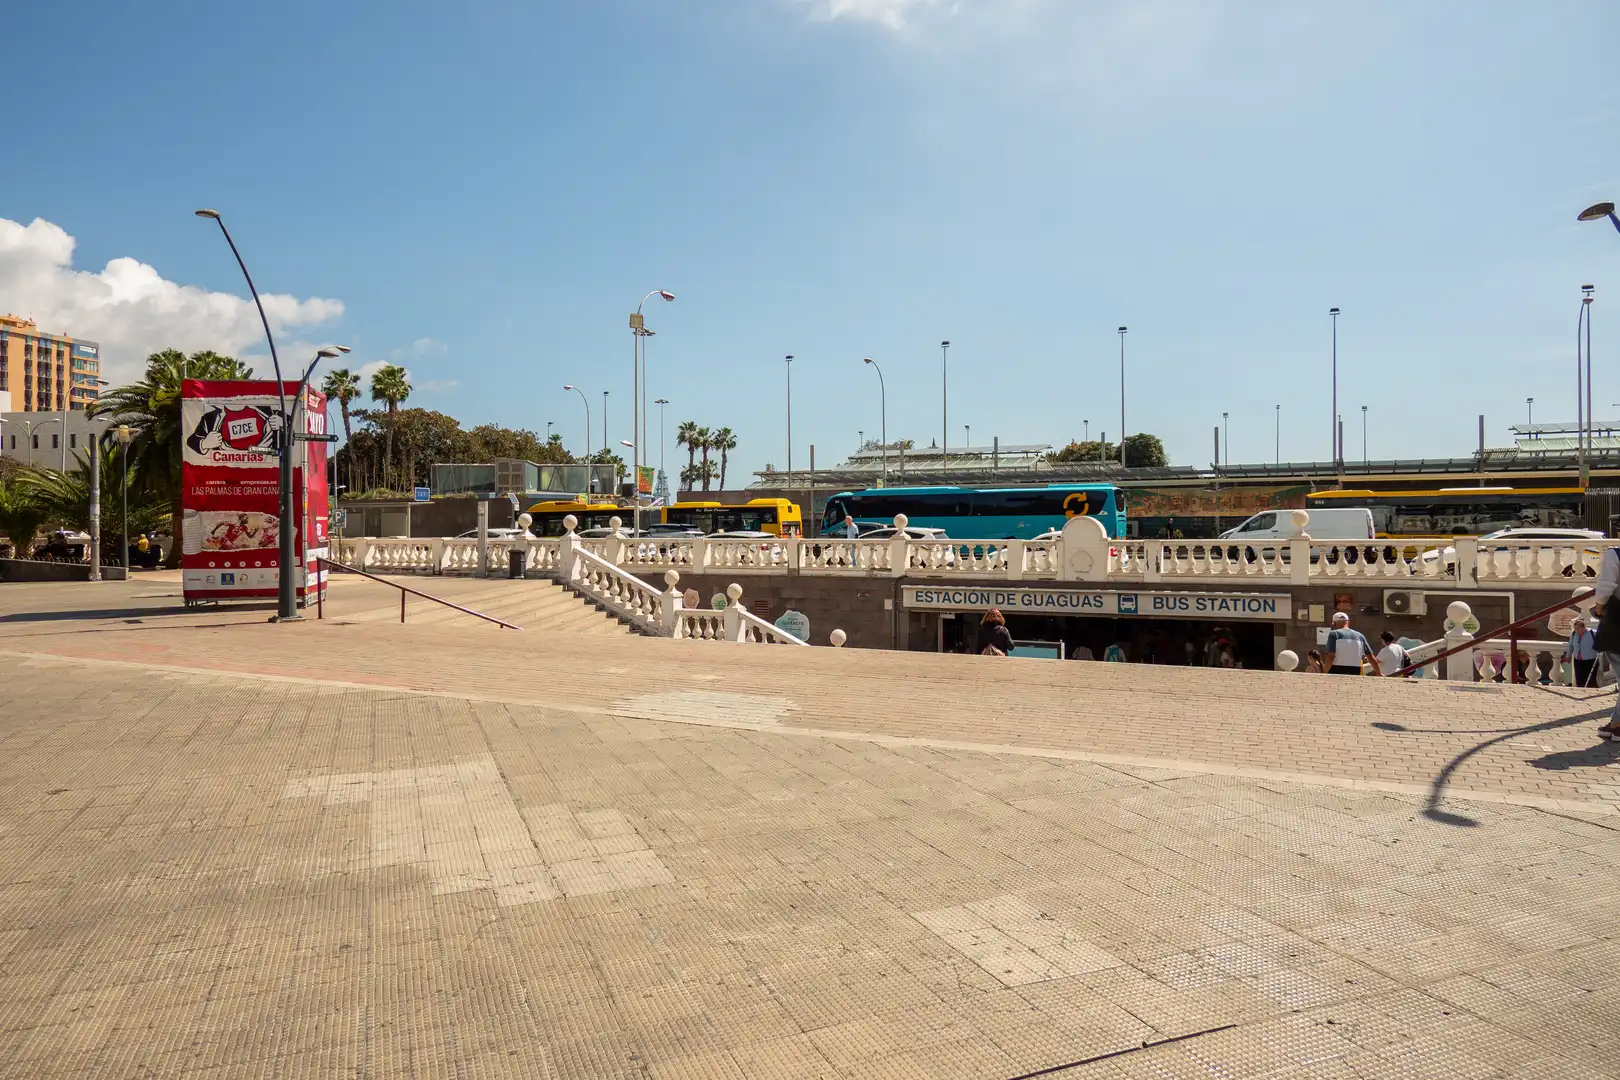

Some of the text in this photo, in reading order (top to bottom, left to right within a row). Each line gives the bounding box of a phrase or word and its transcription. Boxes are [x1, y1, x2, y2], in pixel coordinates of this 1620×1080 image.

[212, 451, 264, 462] Canarias
[191, 486, 205, 496] LAS
[205, 486, 232, 496] PALMAS
[233, 486, 242, 496] DE
[243, 486, 261, 496] GRAN
[915, 589, 1275, 612] ESTACIÓN DE GUAGUAS BUS STATION
